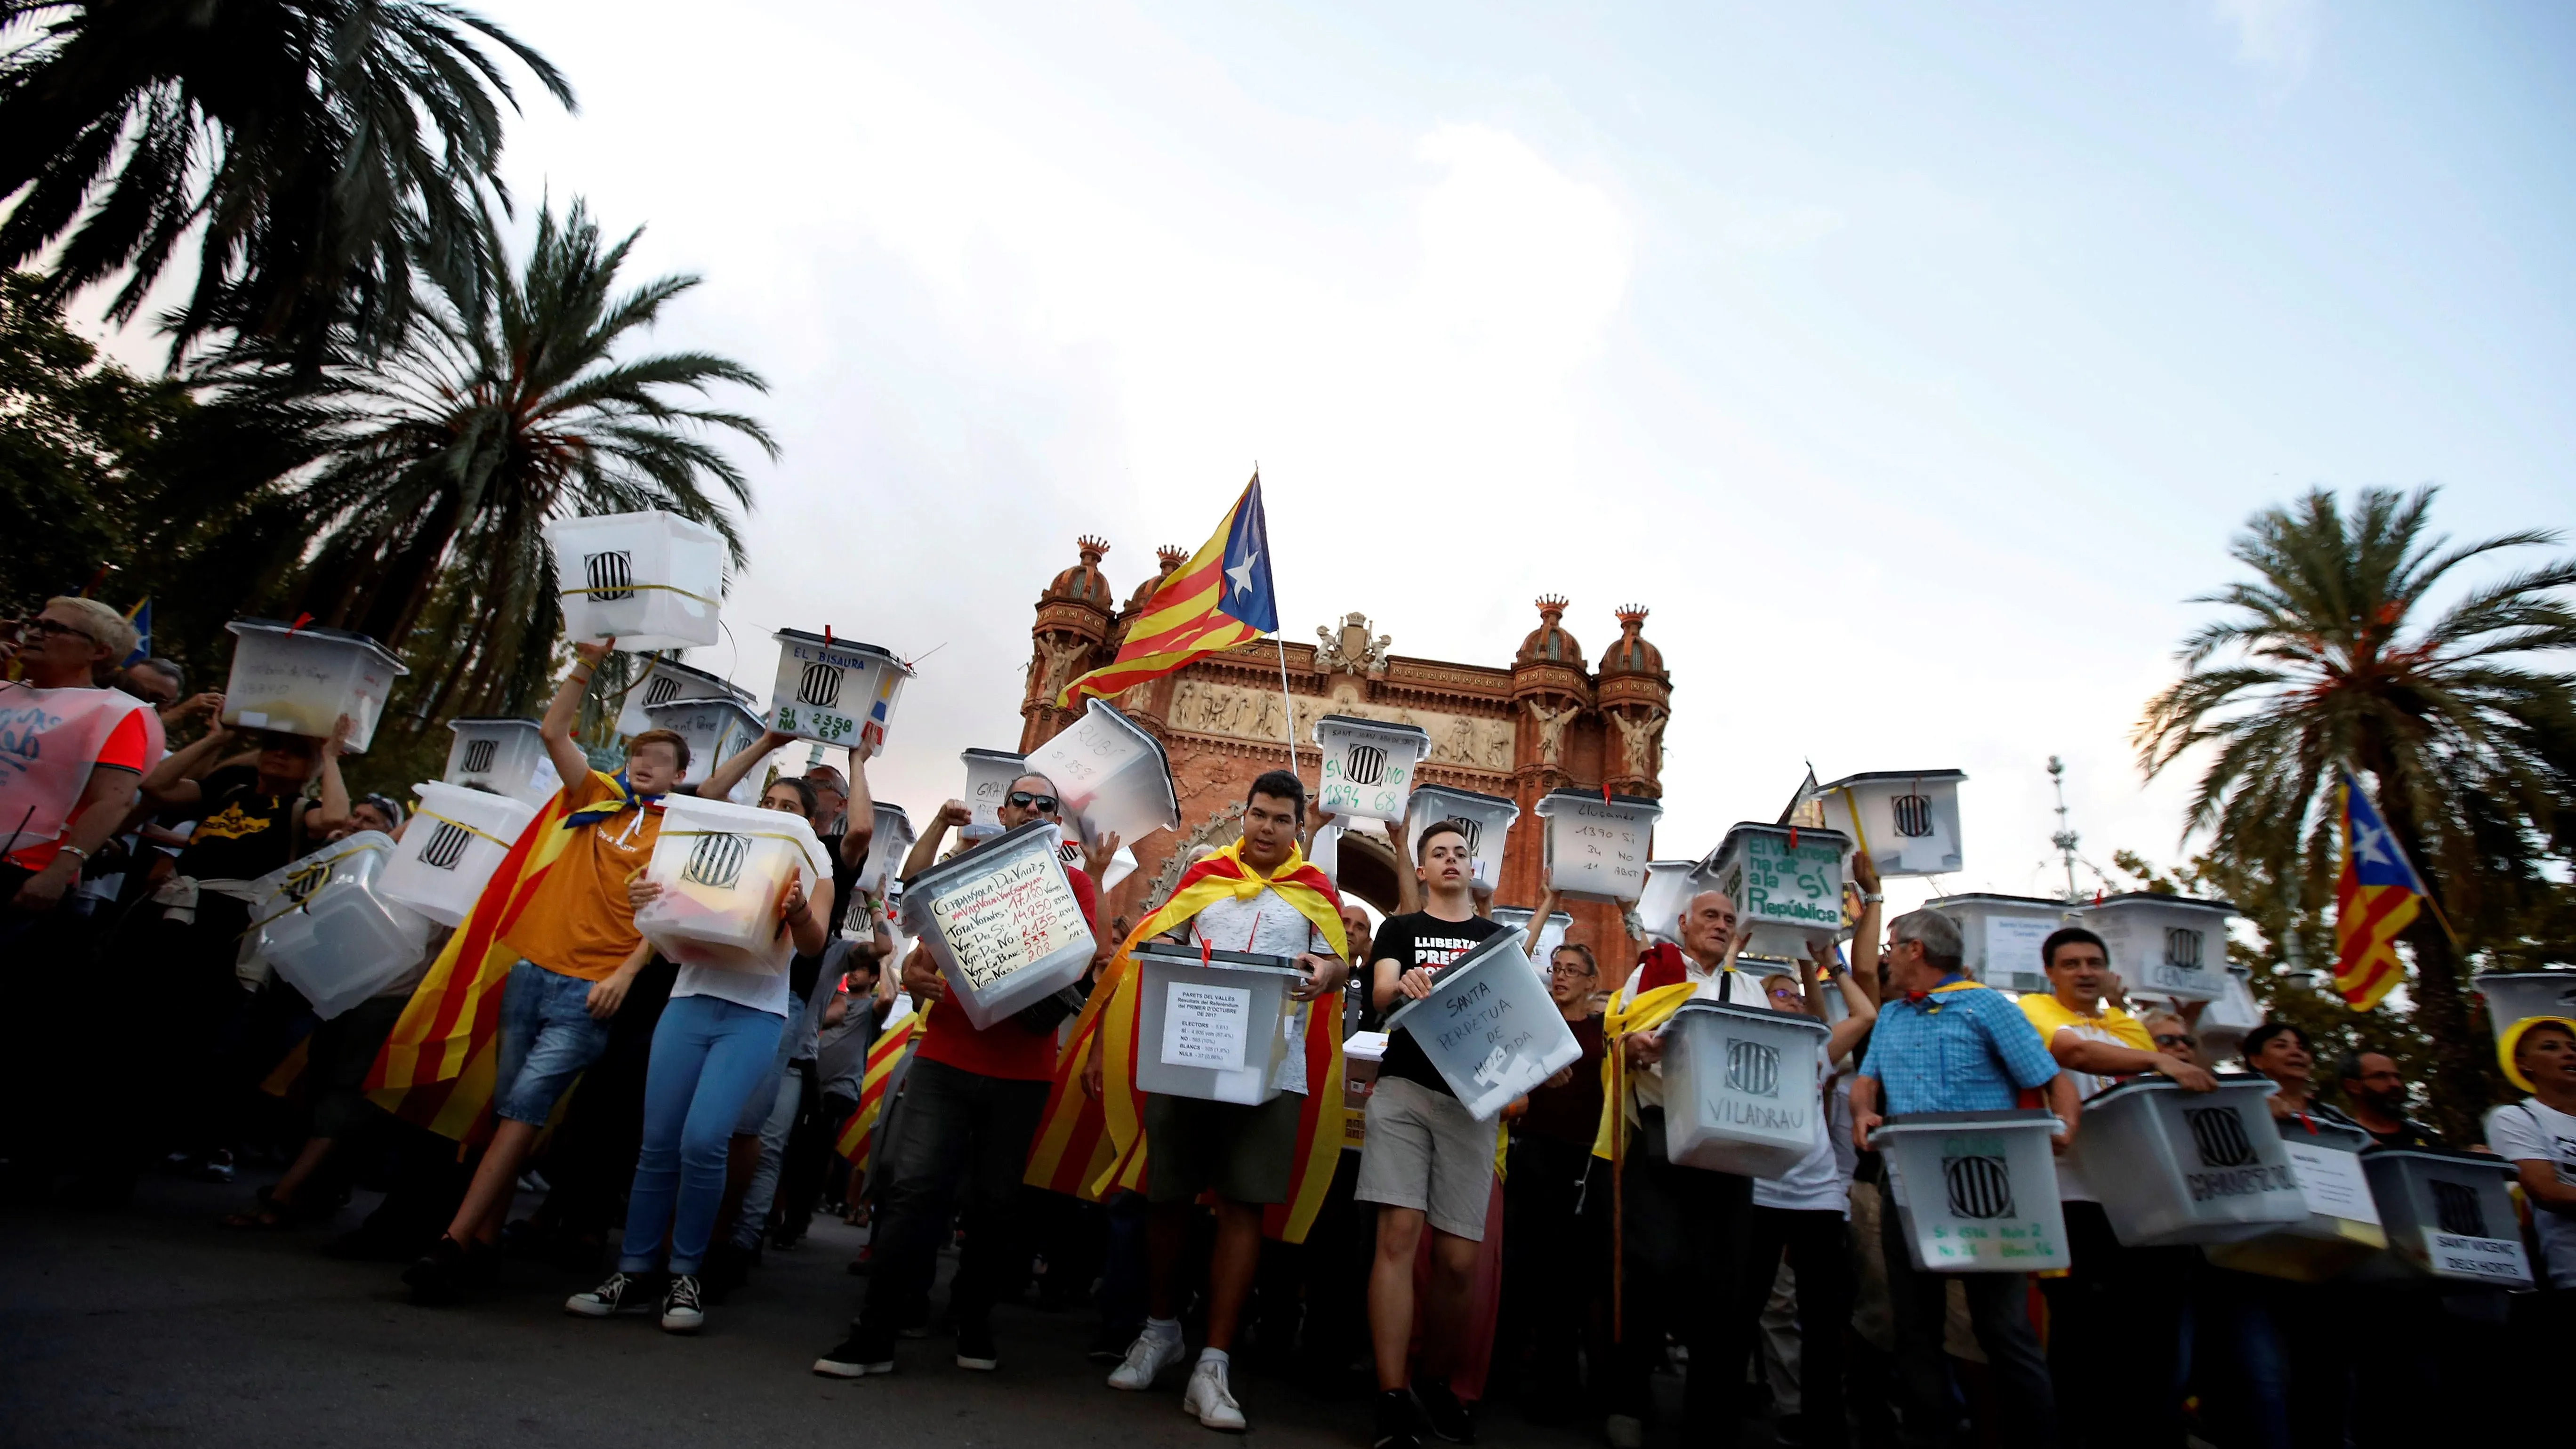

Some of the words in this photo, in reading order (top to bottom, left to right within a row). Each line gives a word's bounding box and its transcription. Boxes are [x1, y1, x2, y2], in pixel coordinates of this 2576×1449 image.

[794, 647, 808, 659] EL
[819, 652, 865, 670] BISAURA
[778, 718, 796, 730] NO
[819, 728, 840, 739] 69
[780, 707, 795, 719] SI
[813, 713, 853, 733] 2358
[1065, 760, 1096, 780] 85%
[1385, 766, 1405, 784] NO
[1375, 791, 1396, 812] 68
[1587, 845, 1601, 855] 34
[1748, 837, 1766, 854] El
[1614, 867, 1639, 877] ABST
[1750, 855, 1772, 871] ha
[1748, 872, 1761, 885] a
[1763, 871, 1779, 888] la
[1013, 898, 1051, 925] 14.250
[1748, 887, 1837, 923] República
[946, 923, 974, 938] TOTAL
[1021, 912, 1057, 937] 2.135
[1024, 931, 1048, 950] 533
[1415, 937, 1480, 950] LLIBERTA
[1028, 942, 1055, 962] 202
[1415, 950, 1465, 965] PRES
[1447, 981, 1491, 1018] SANTA
[1487, 1026, 1505, 1044] DE
[1708, 1097, 1803, 1129] VILADRAU
[2436, 1235, 2469, 1251] SANT
[2446, 1256, 2478, 1270] DELS
